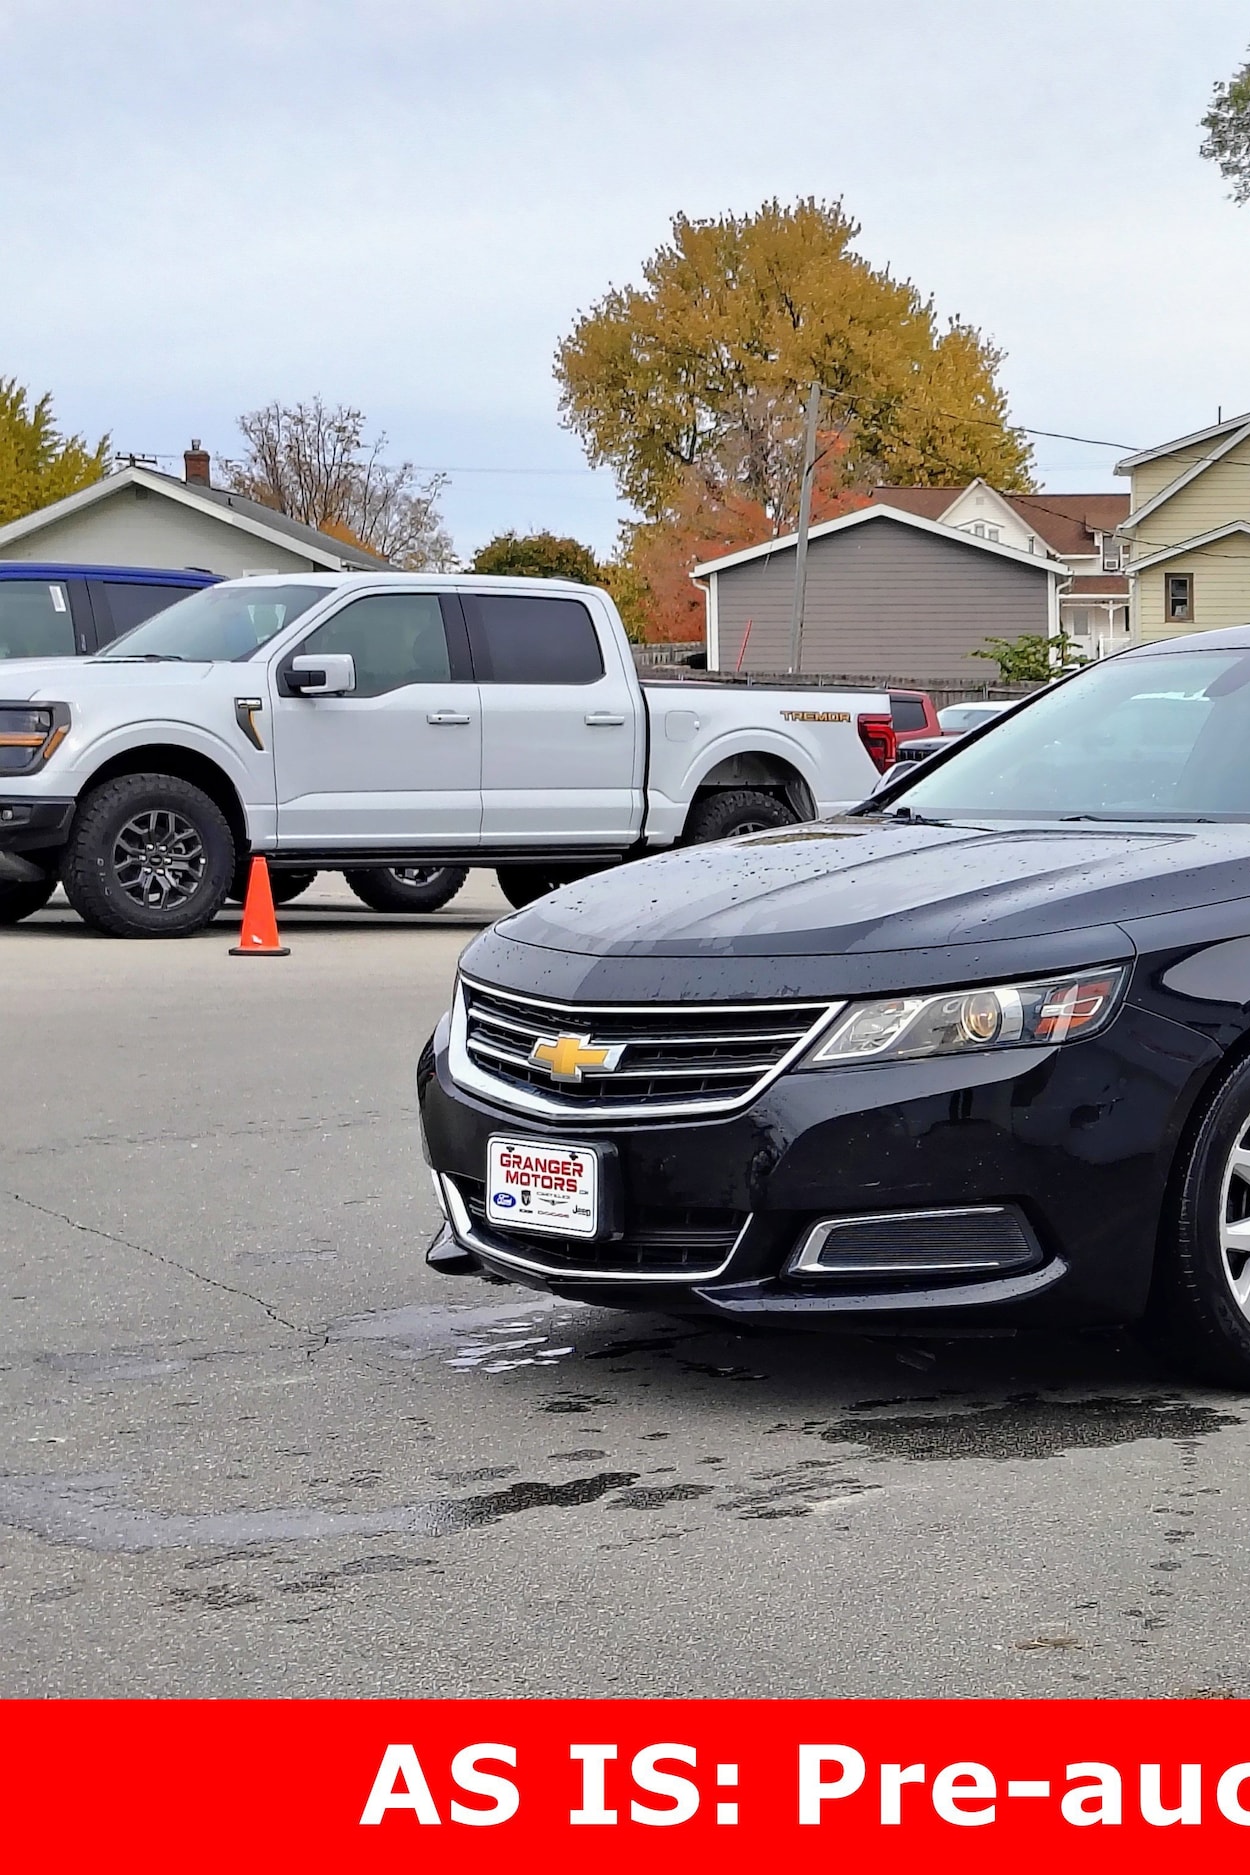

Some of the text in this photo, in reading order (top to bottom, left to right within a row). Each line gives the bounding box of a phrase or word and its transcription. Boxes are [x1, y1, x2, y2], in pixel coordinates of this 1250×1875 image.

[780, 710, 851, 723] TREMOR
[500, 1152, 584, 1178] GRANGER
[505, 1169, 578, 1193] MOTORS
